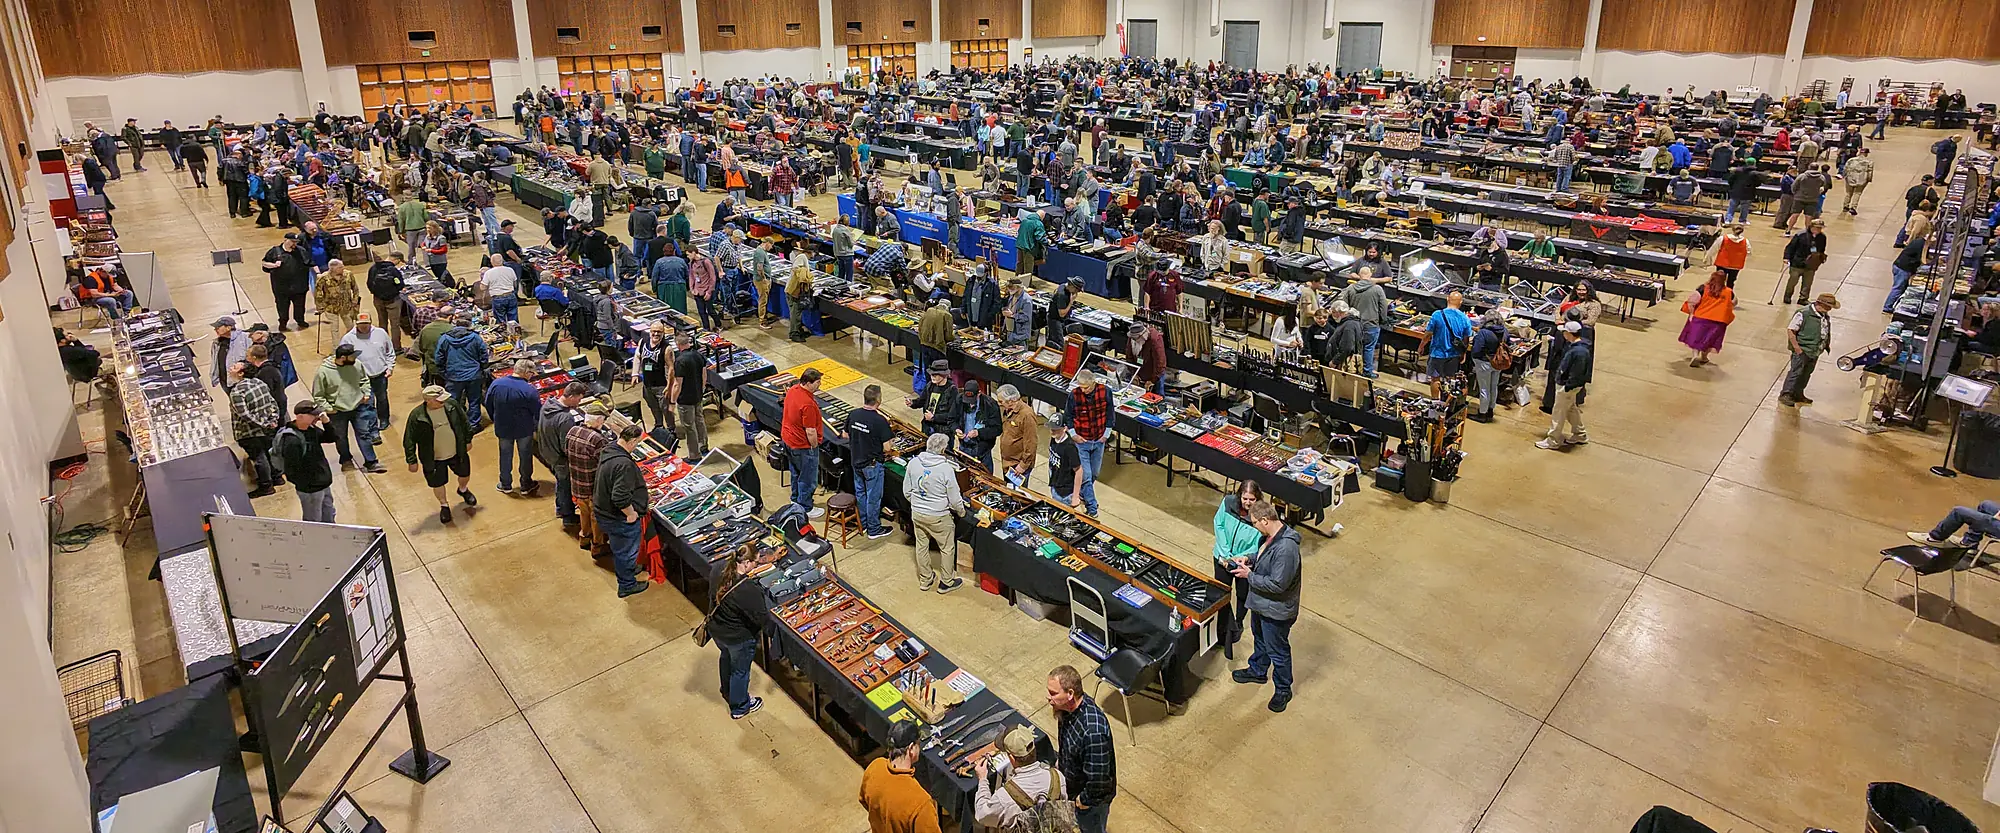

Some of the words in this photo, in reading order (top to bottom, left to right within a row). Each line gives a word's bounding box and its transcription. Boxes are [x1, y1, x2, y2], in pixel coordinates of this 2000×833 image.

[668, 190, 677, 200] R
[457, 220, 467, 232] T
[347, 235, 358, 248] U
[1333, 481, 1341, 506] S
[1202, 615, 1215, 648] T
